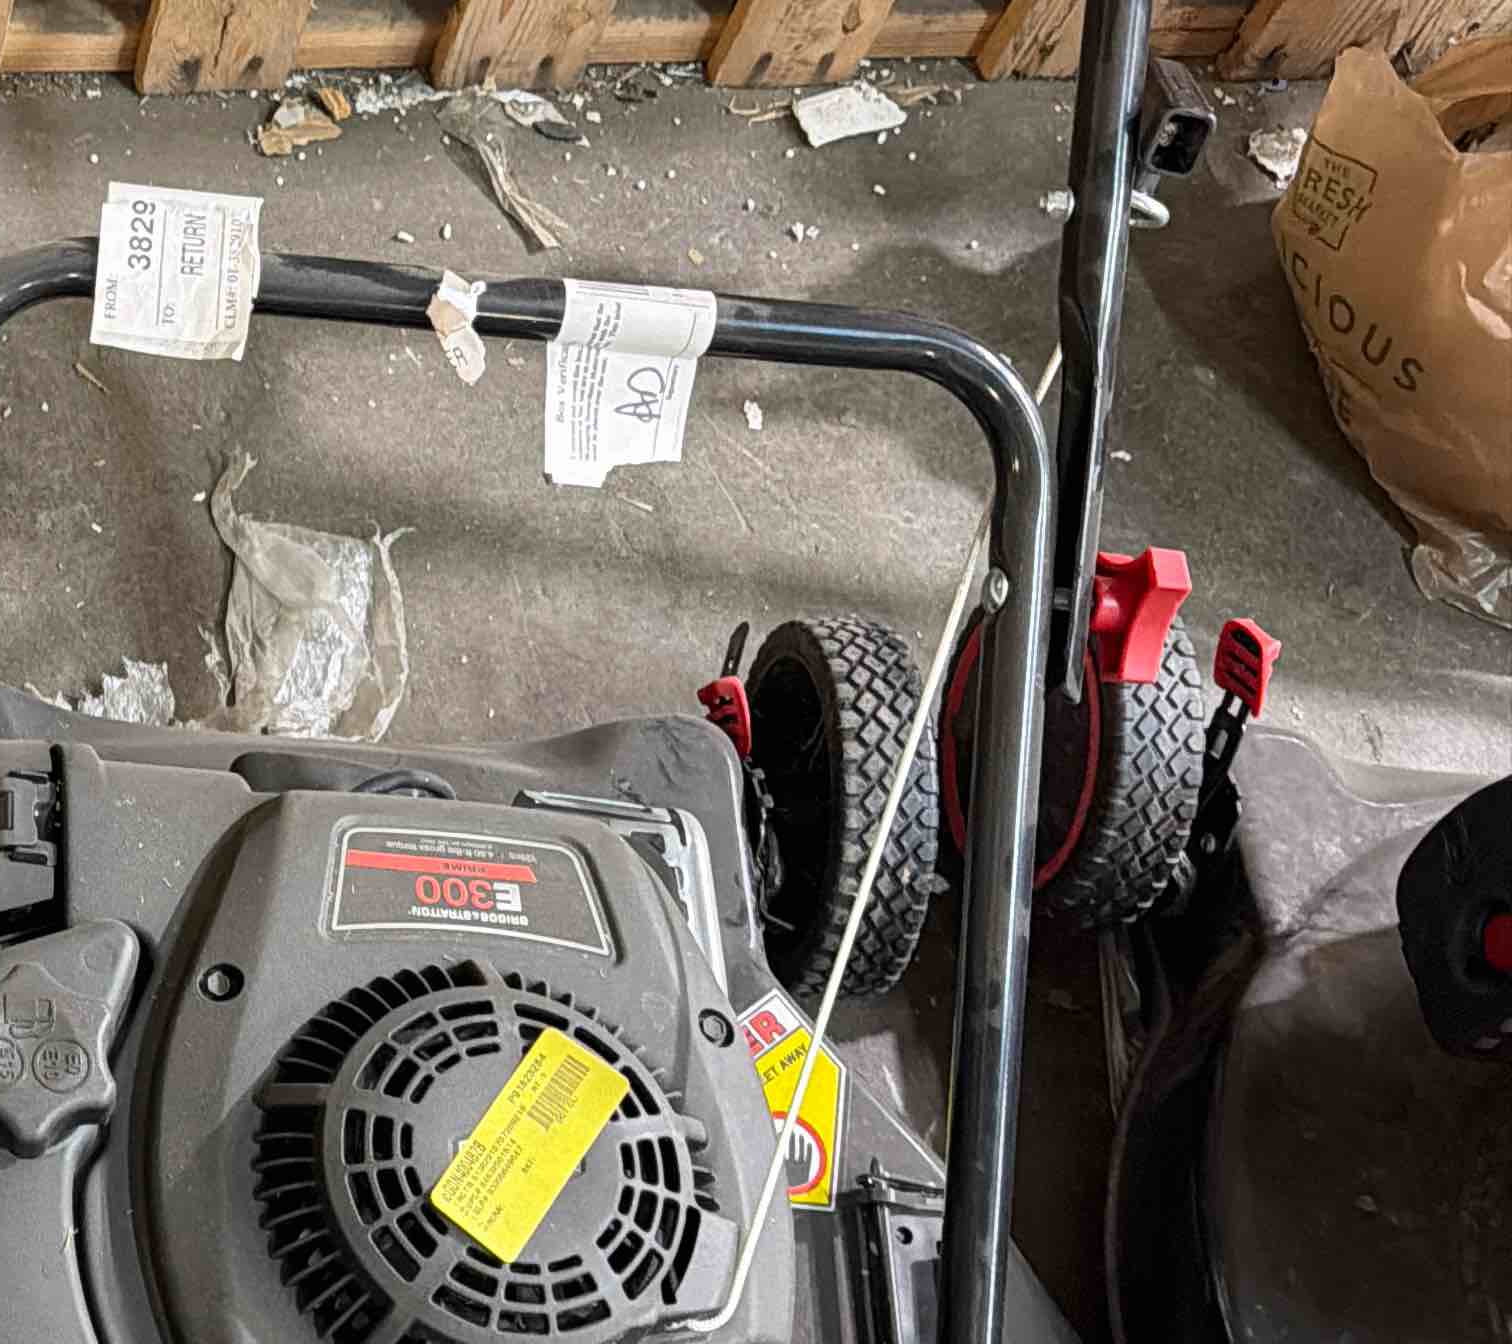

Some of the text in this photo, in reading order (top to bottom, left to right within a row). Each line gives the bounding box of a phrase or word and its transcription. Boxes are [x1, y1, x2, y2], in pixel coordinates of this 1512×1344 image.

[1304, 168, 1373, 223] RESH
[128, 200, 156, 271] 3829
[180, 213, 206, 276] RETURN
[416, 875, 522, 912] E300
[780, 1042, 808, 1071] AWAY
